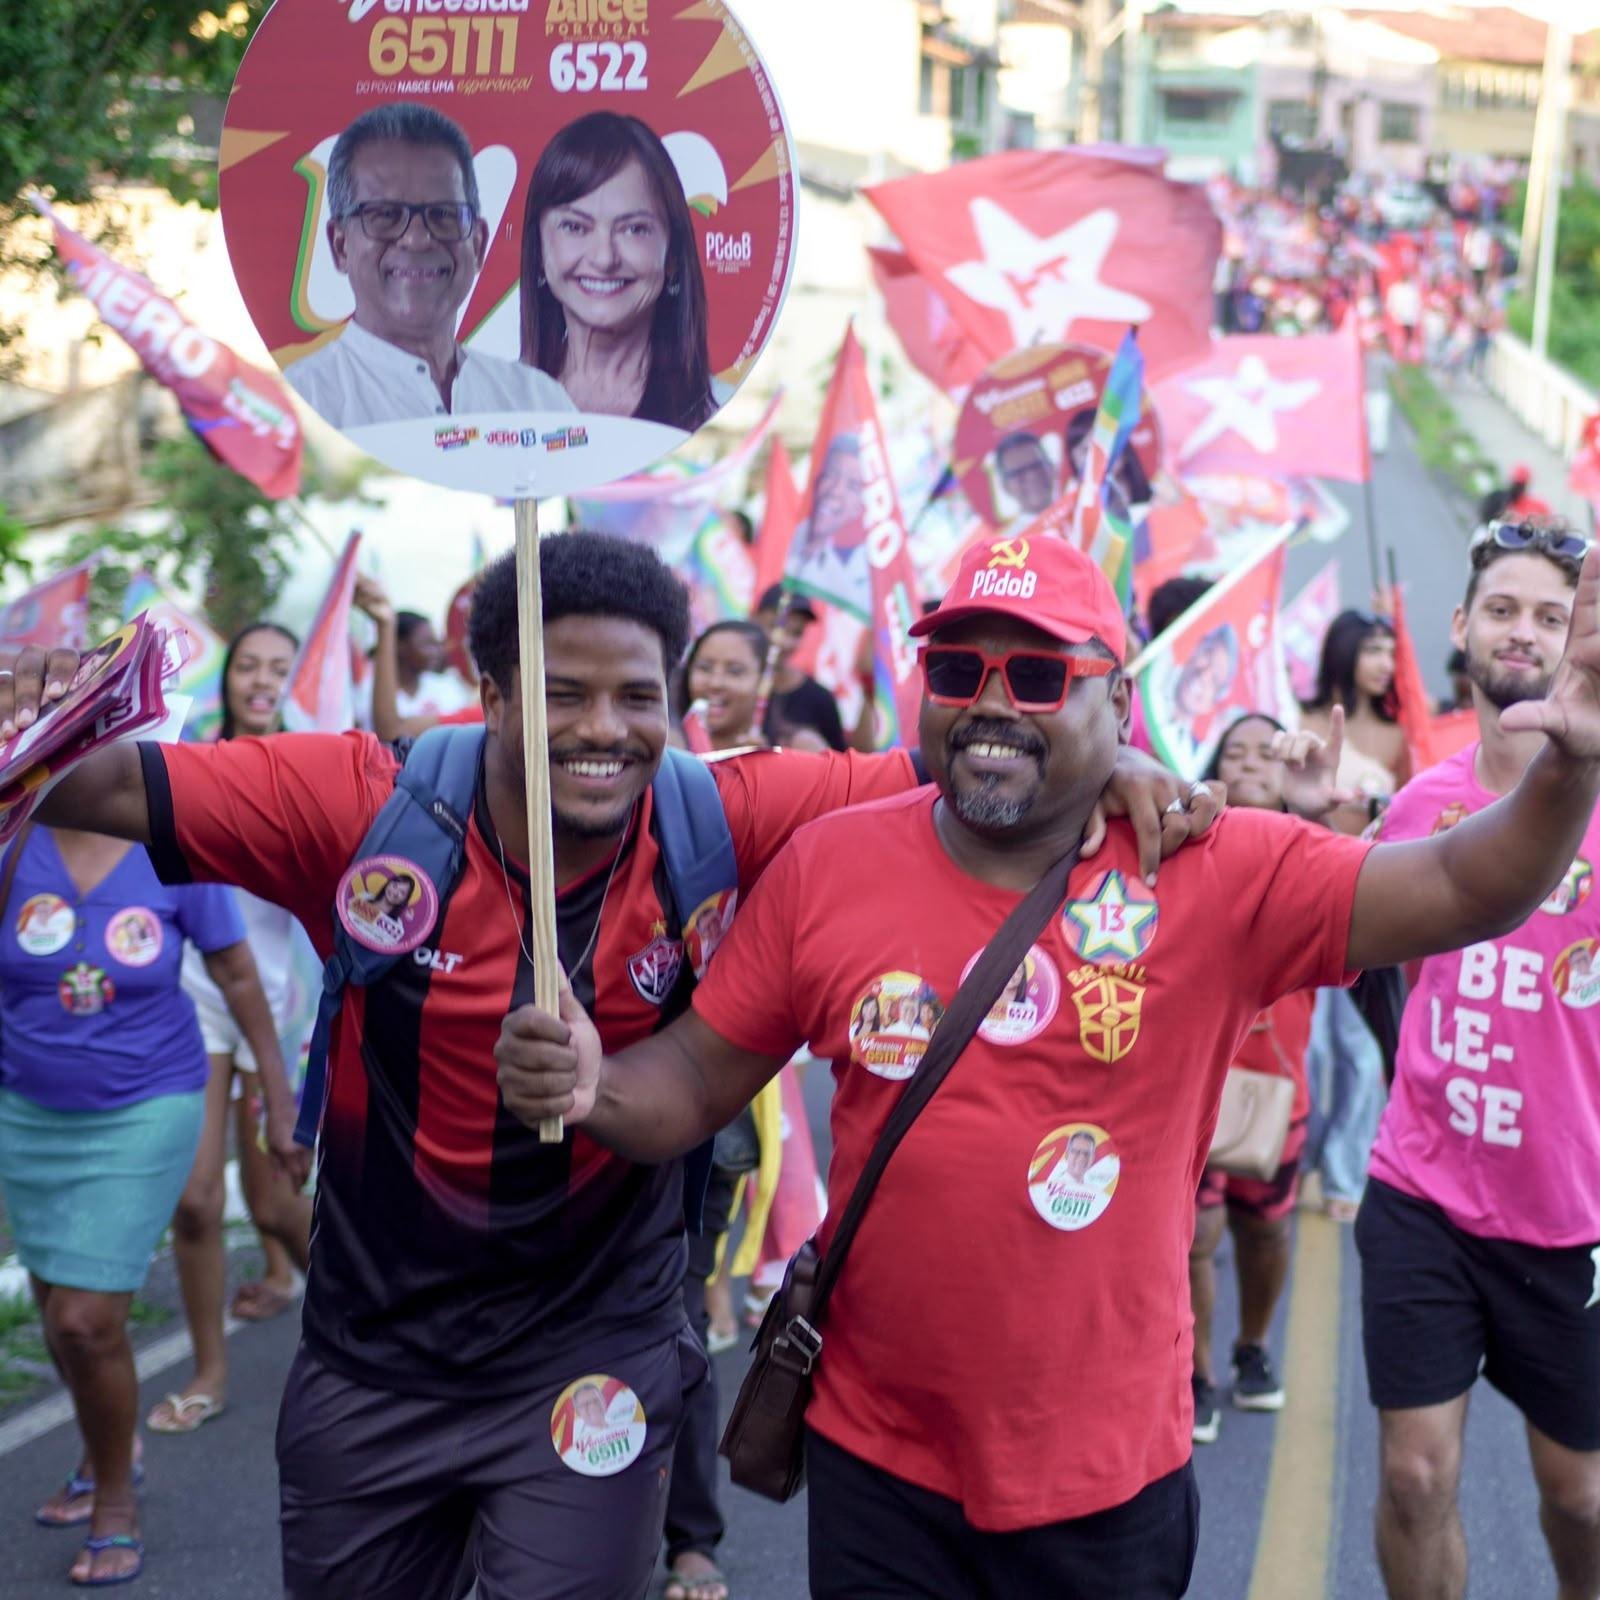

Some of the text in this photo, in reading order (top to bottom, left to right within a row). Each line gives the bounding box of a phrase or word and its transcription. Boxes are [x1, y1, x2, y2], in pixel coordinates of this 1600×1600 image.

[545, 22, 650, 37] PORTUGAL
[368, 16, 519, 76] 65111
[549, 41, 648, 92] 6522
[397, 79, 431, 93] NASCE
[432, 79, 455, 93] UMA
[705, 231, 751, 260] PCdoB
[969, 567, 1038, 600] PCdoB
[1098, 902, 1127, 932] 13
[413, 946, 464, 975] OLT
[1457, 940, 1544, 1012] BE
[1445, 1076, 1523, 1150] SE
